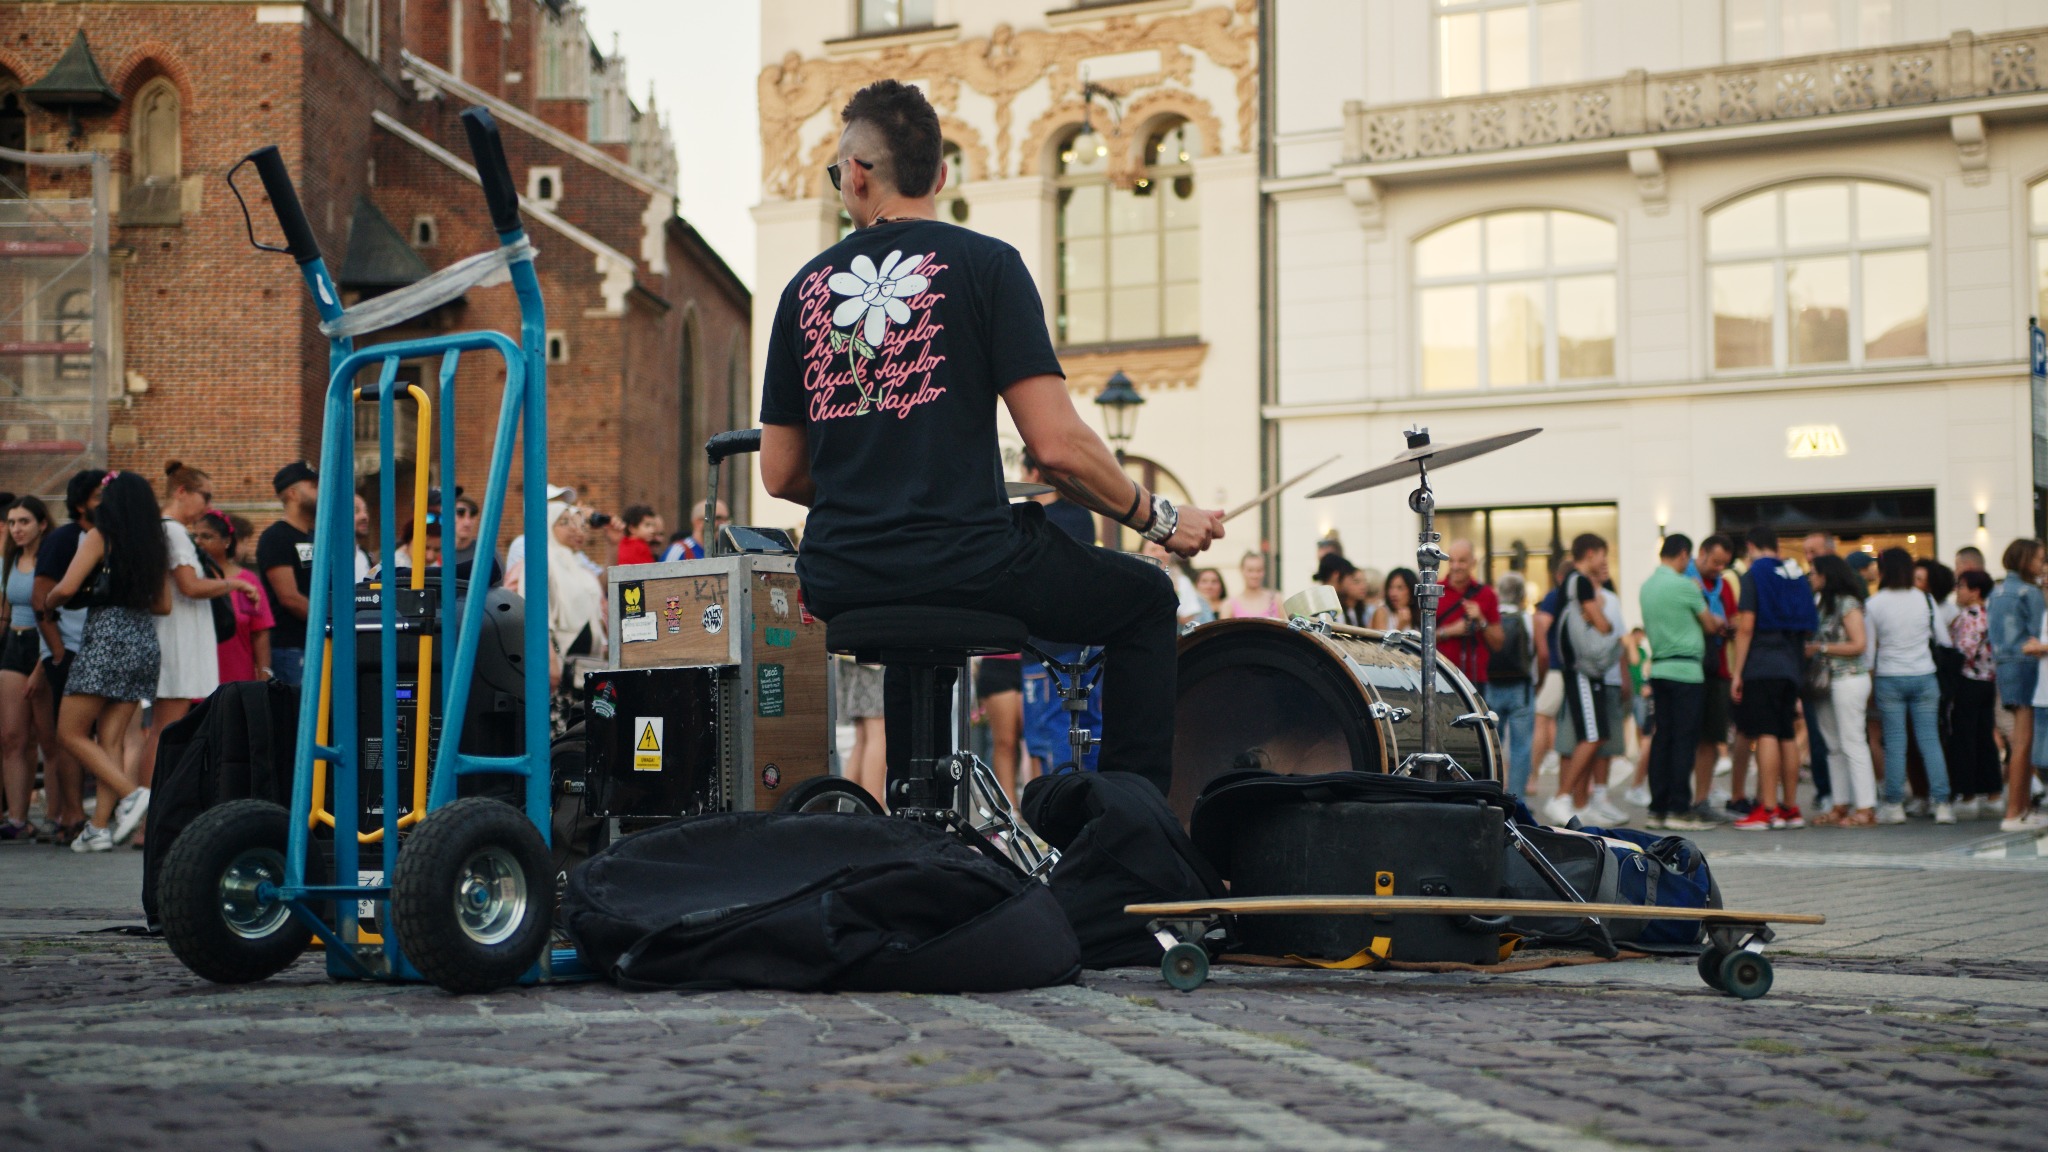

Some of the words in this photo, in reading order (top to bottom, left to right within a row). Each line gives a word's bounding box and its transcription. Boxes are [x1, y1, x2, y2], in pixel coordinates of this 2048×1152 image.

[804, 355, 869, 391] Chuck
[875, 340, 946, 388] Taylor
[876, 372, 946, 420] Taylor
